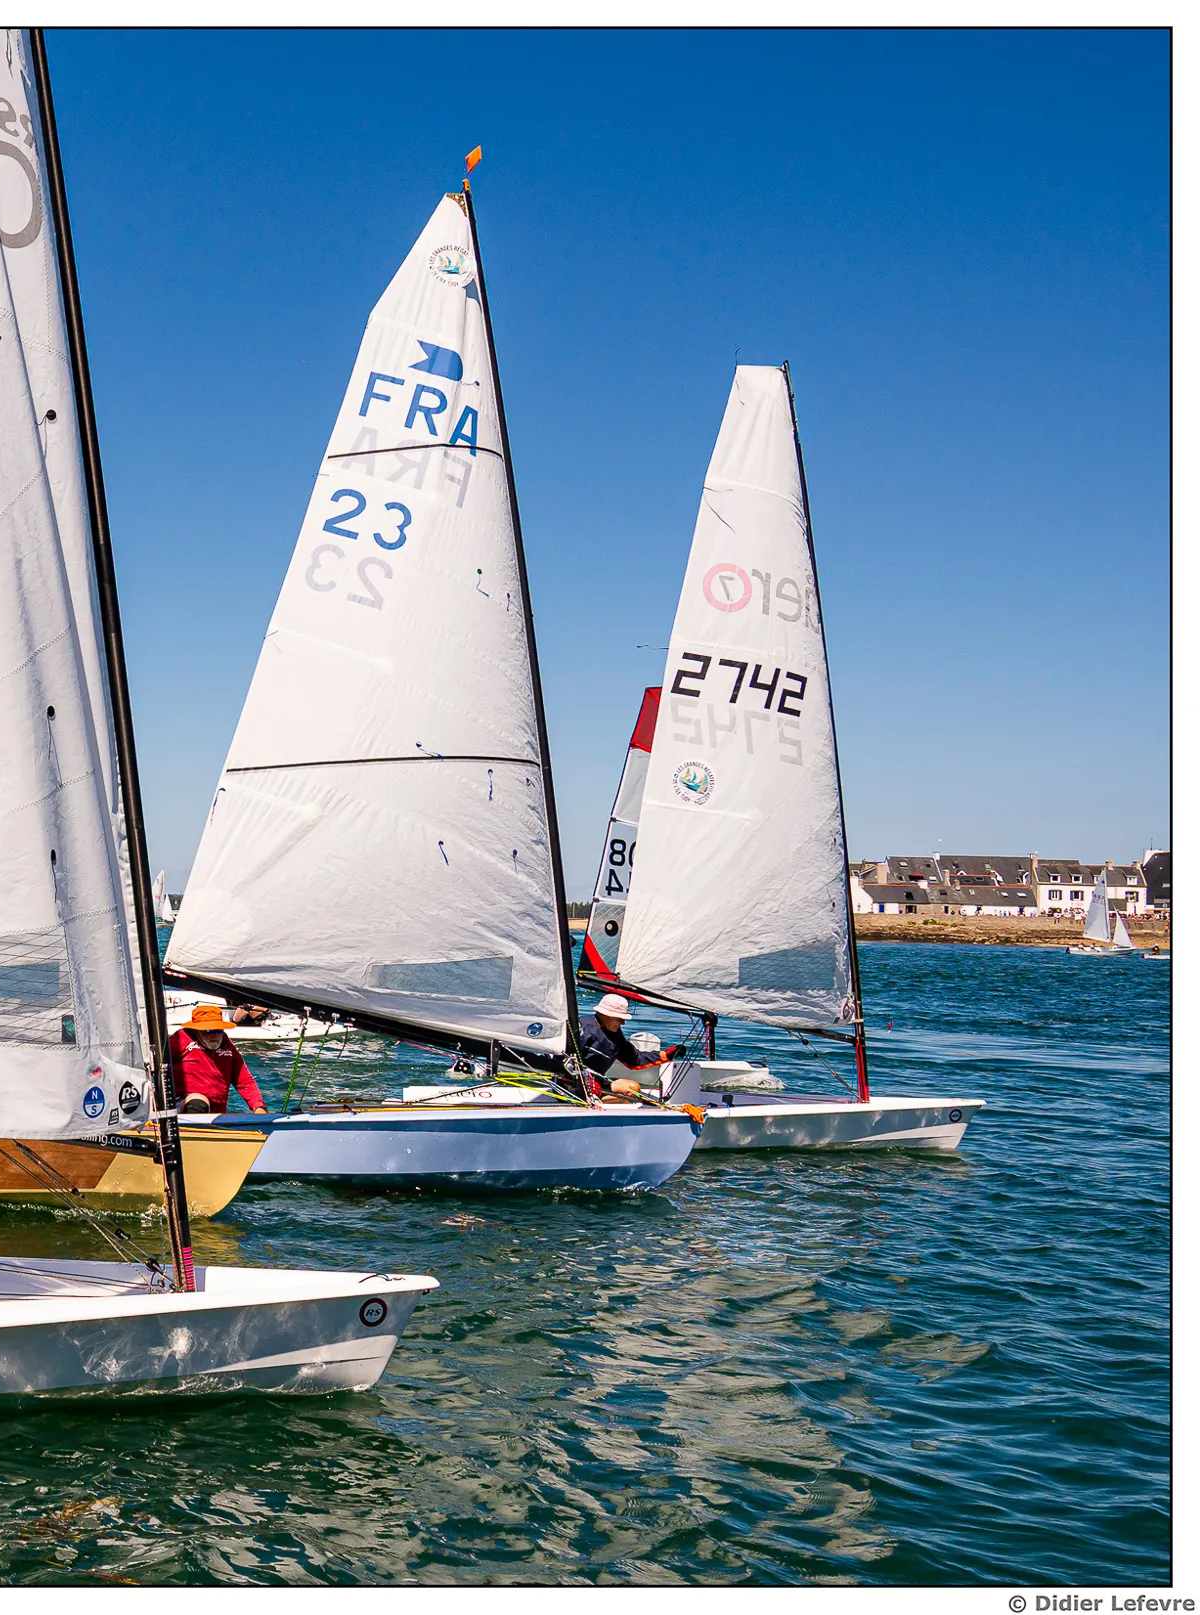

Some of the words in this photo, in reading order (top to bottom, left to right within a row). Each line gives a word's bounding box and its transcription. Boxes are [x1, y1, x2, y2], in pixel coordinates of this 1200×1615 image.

[358, 371, 479, 457] FRA
[322, 488, 412, 550] 23
[670, 652, 808, 717] 2742
[121, 1086, 138, 1101] RS
[366, 1308, 381, 1317] RS
